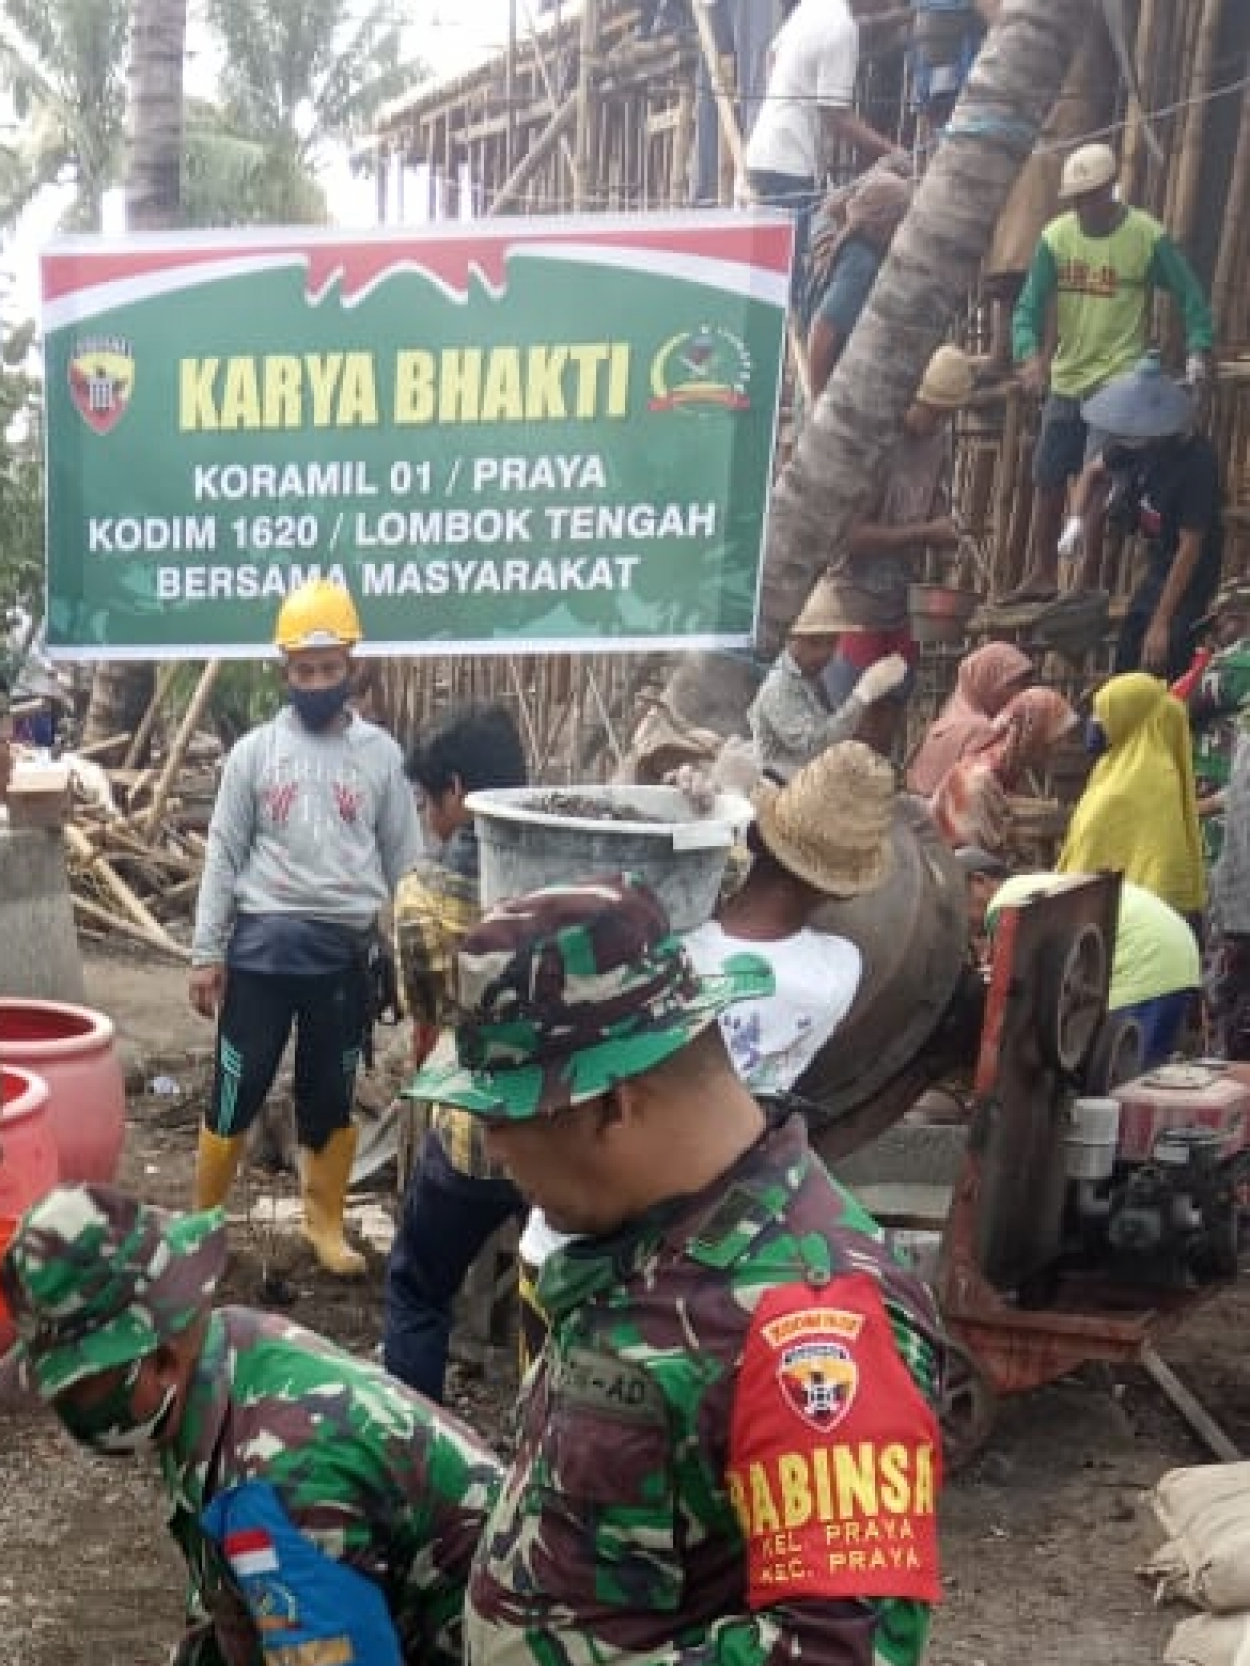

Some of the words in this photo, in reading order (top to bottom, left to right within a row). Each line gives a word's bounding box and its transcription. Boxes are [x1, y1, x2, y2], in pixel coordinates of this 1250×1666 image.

[179, 351, 378, 431] KARYA
[394, 343, 629, 425] BHAKTI
[194, 461, 378, 499] KORAMIL
[390, 461, 431, 494] 01
[446, 457, 461, 496] /
[473, 455, 606, 491] PRAYA
[88, 515, 217, 551] KODIM
[232, 514, 318, 549] 1620
[329, 512, 343, 552] /
[355, 508, 532, 546] LOMBOK
[544, 504, 716, 541] TENGAH
[361, 556, 641, 597] MASYARAKAT
[826, 1518, 913, 1545] PRAYA
[829, 1547, 920, 1574] PRAYA
